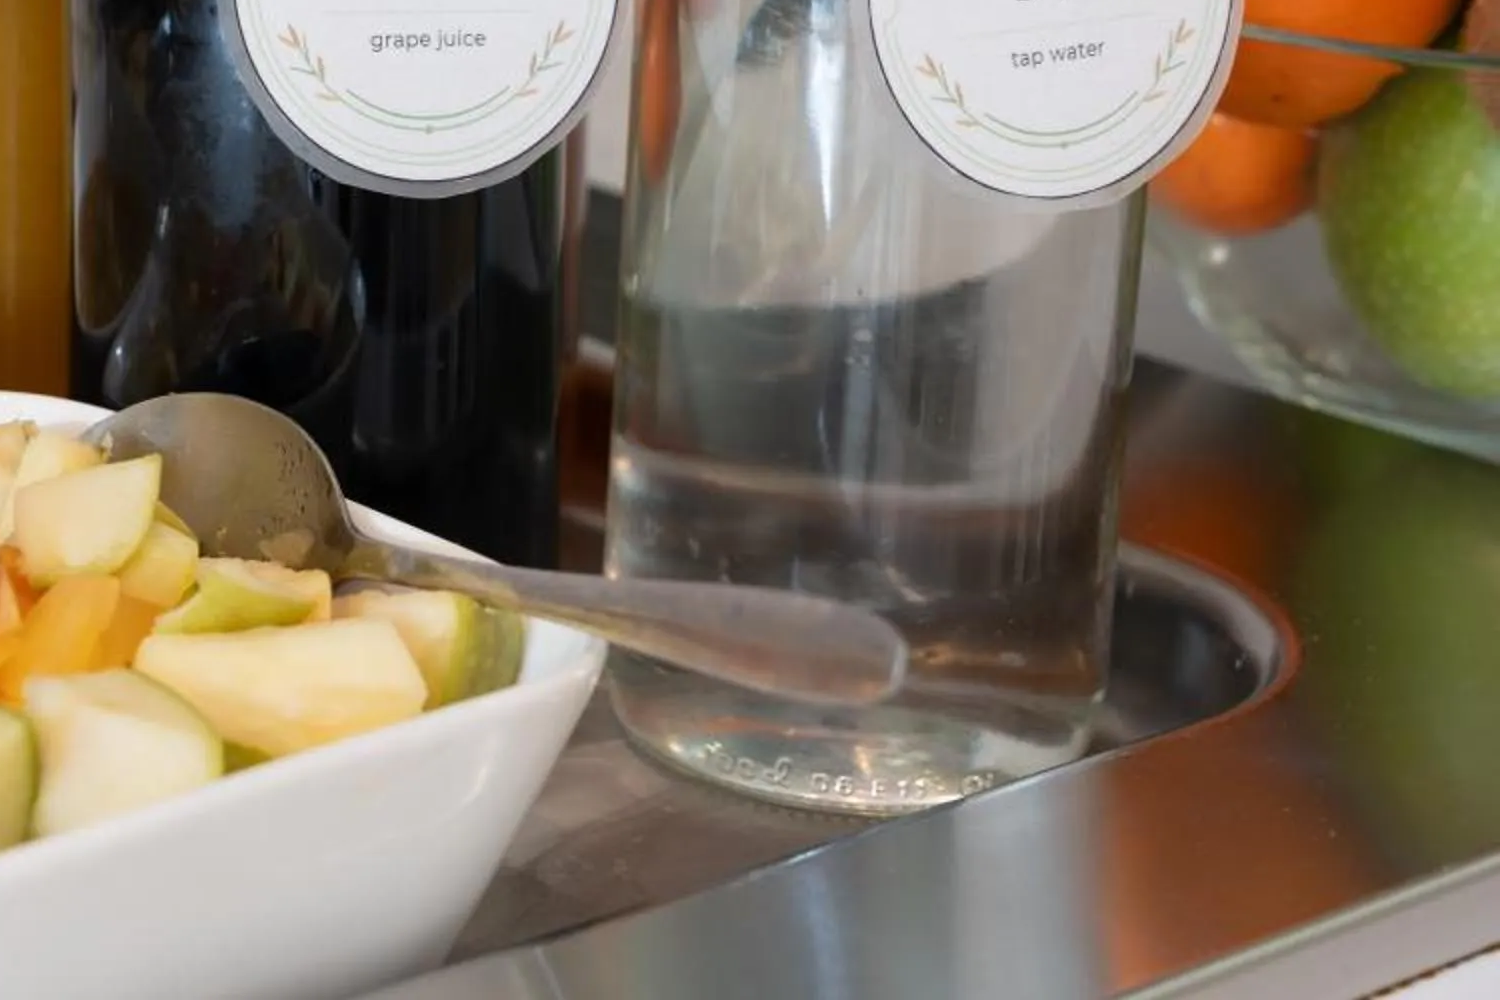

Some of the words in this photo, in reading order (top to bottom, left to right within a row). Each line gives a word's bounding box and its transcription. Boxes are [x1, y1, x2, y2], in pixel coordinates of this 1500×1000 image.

[369, 32, 432, 52] grape
[436, 27, 488, 51] juice
[1011, 49, 1045, 69] tap
[1048, 40, 1105, 62] water
